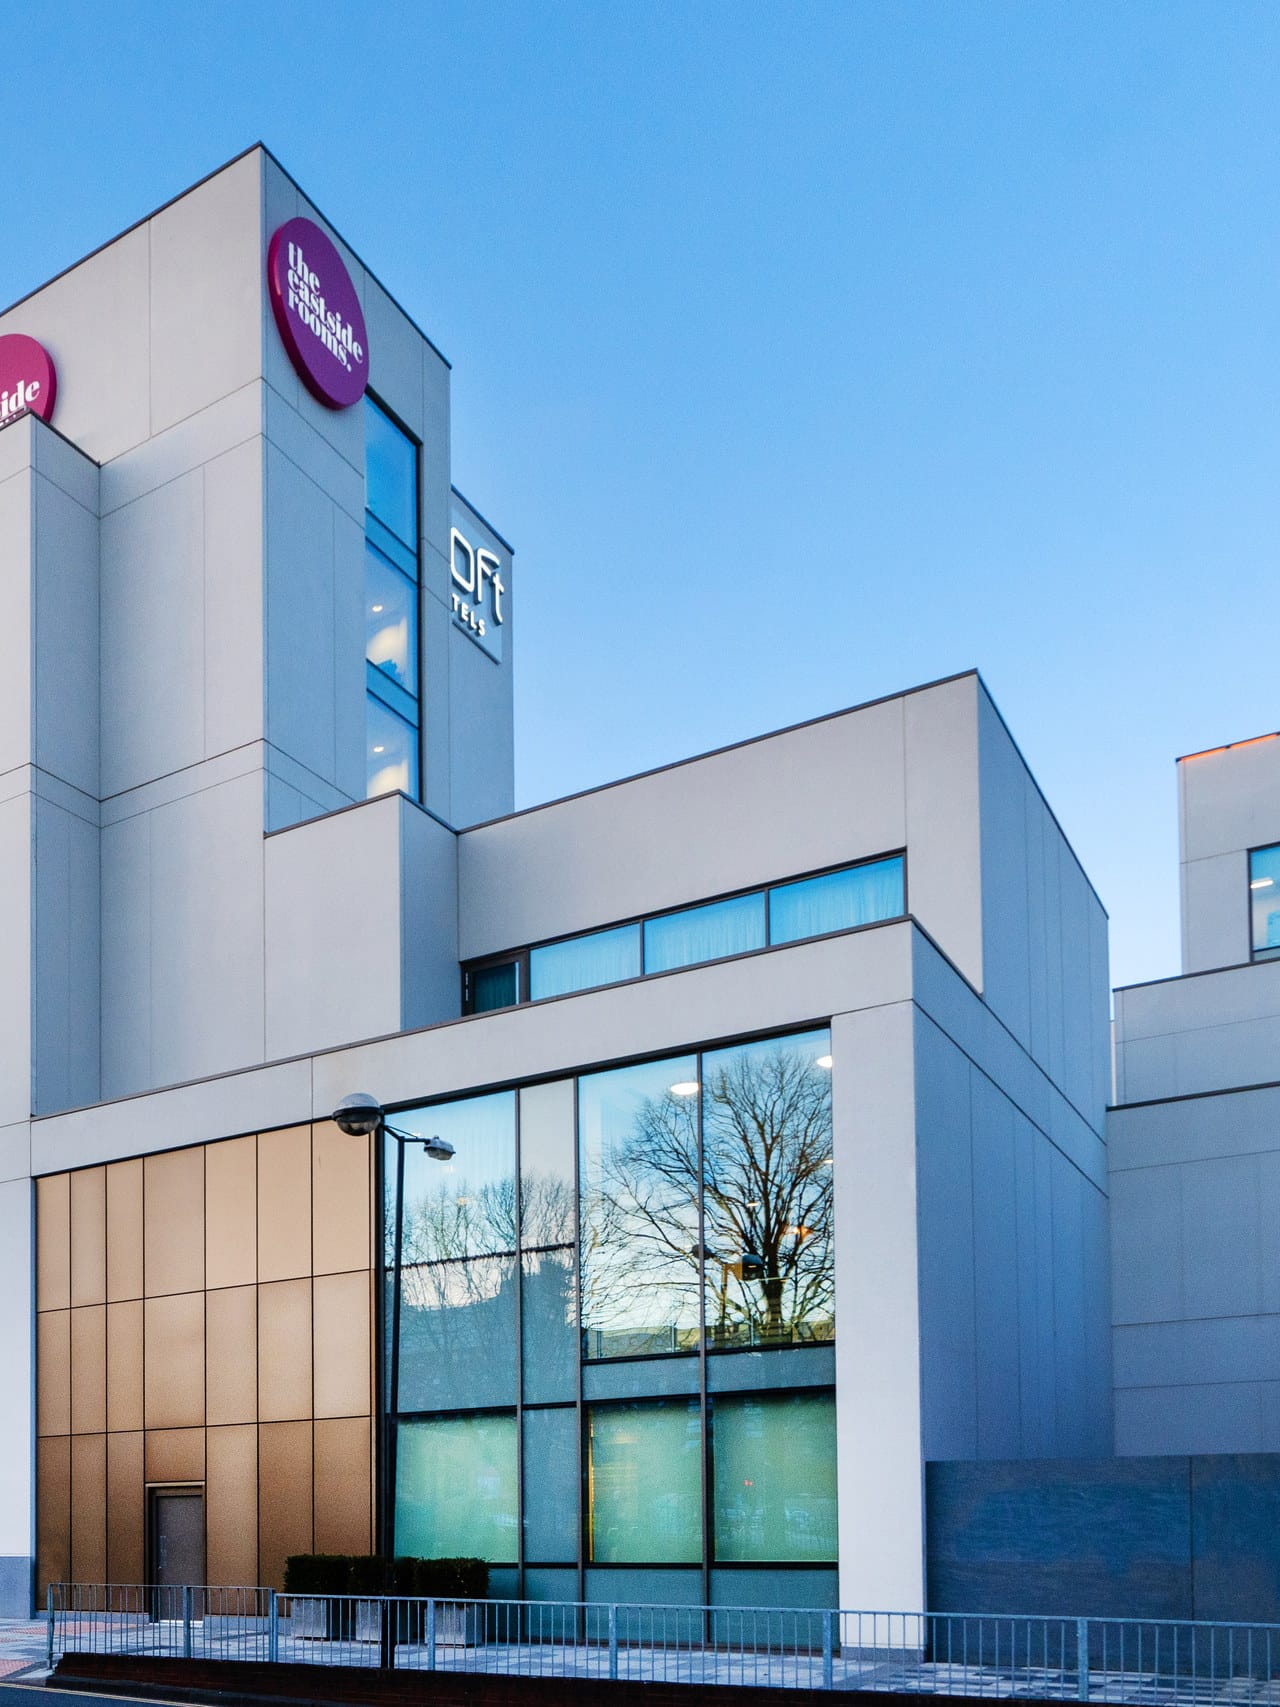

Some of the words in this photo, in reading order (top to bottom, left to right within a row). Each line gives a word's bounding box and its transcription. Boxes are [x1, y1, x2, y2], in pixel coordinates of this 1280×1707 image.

[288, 241, 320, 295] the
[288, 268, 363, 364] eastside
[288, 287, 352, 372] rooms.
[452, 592, 485, 637] TELS
